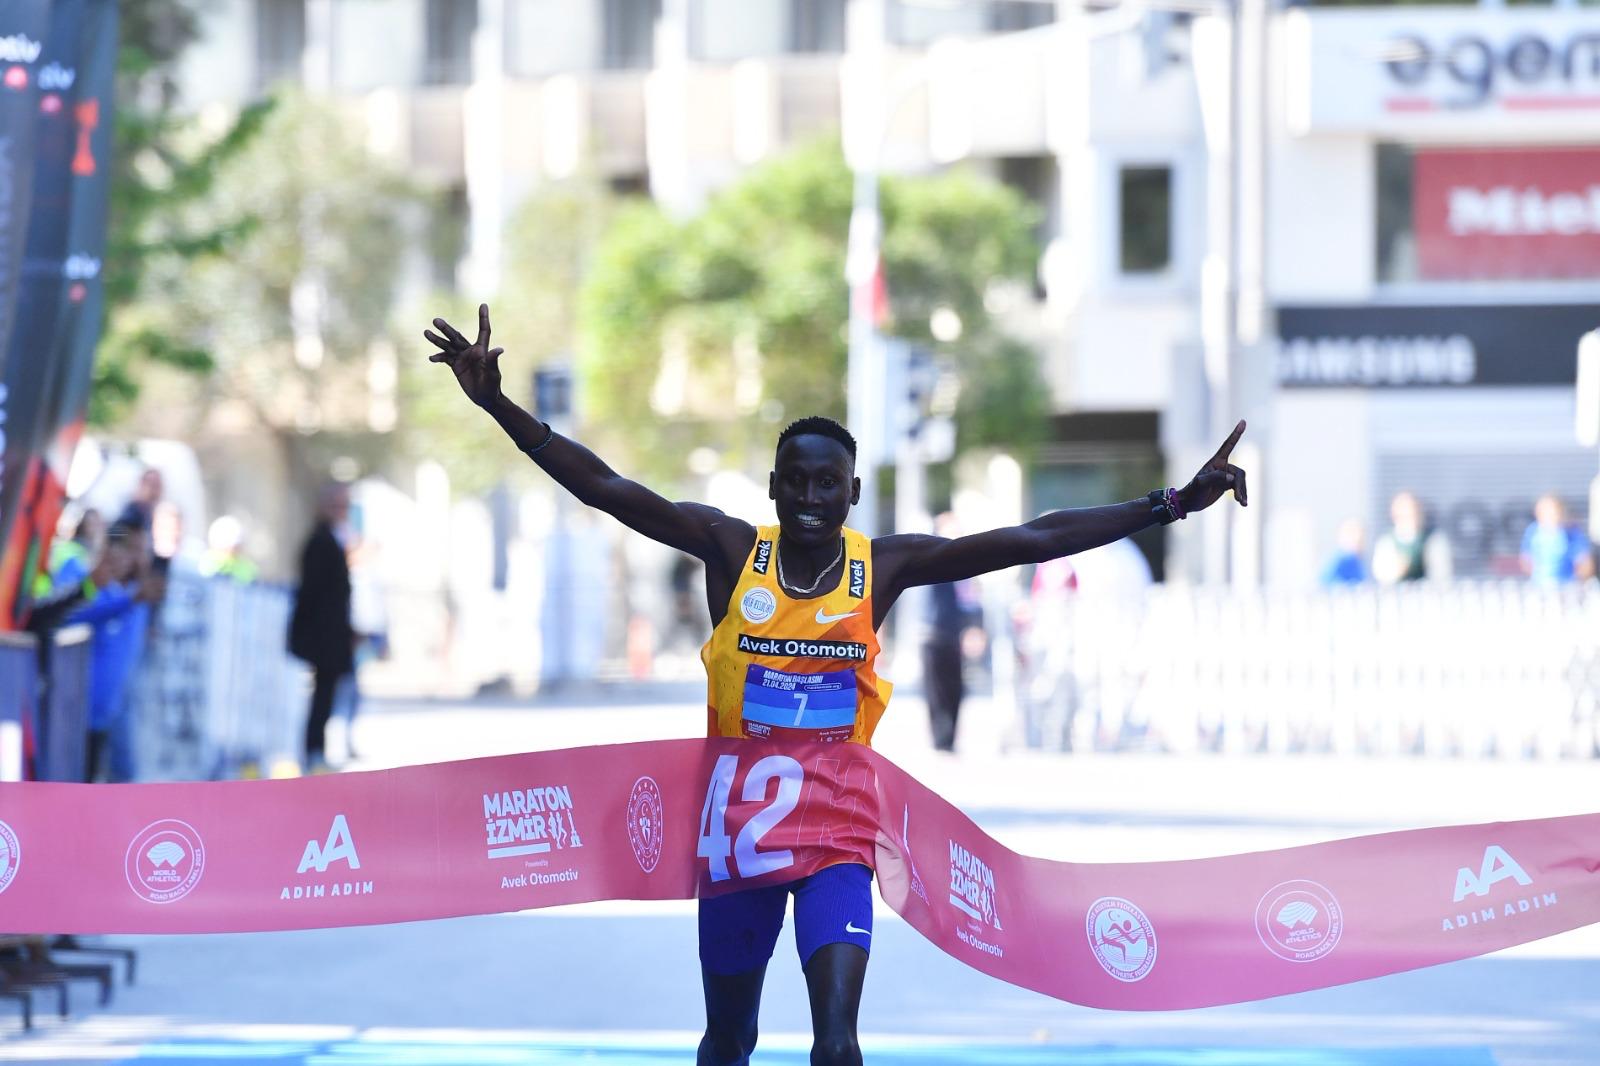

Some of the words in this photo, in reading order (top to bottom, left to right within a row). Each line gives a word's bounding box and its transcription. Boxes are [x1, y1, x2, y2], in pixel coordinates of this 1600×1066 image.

[754, 541, 771, 573] Avek
[850, 561, 863, 597] Avek
[739, 636, 780, 654] Avek
[785, 640, 866, 659] Otomotiv
[762, 678, 797, 691] 21.04.2024
[763, 670, 793, 683] MARATON
[793, 692, 808, 726] 7
[483, 785, 573, 819] MARATON
[486, 814, 549, 845] İZMİR
[949, 839, 995, 893] MARATON
[280, 884, 325, 900] ADIM
[331, 880, 373, 896] ADIM
[501, 873, 528, 889] Avek
[529, 868, 578, 885] Otomotiv
[950, 863, 980, 908] İZMİR
[1442, 908, 1496, 931] ADIM
[1504, 892, 1558, 917] ADIM
[1285, 932, 1322, 944] ATHLETICS
[1288, 927, 1314, 937] WORLD
[969, 934, 1003, 958] Otomotiv
[1295, 951, 1315, 959] ROAD
[1316, 942, 1331, 955] RACE
